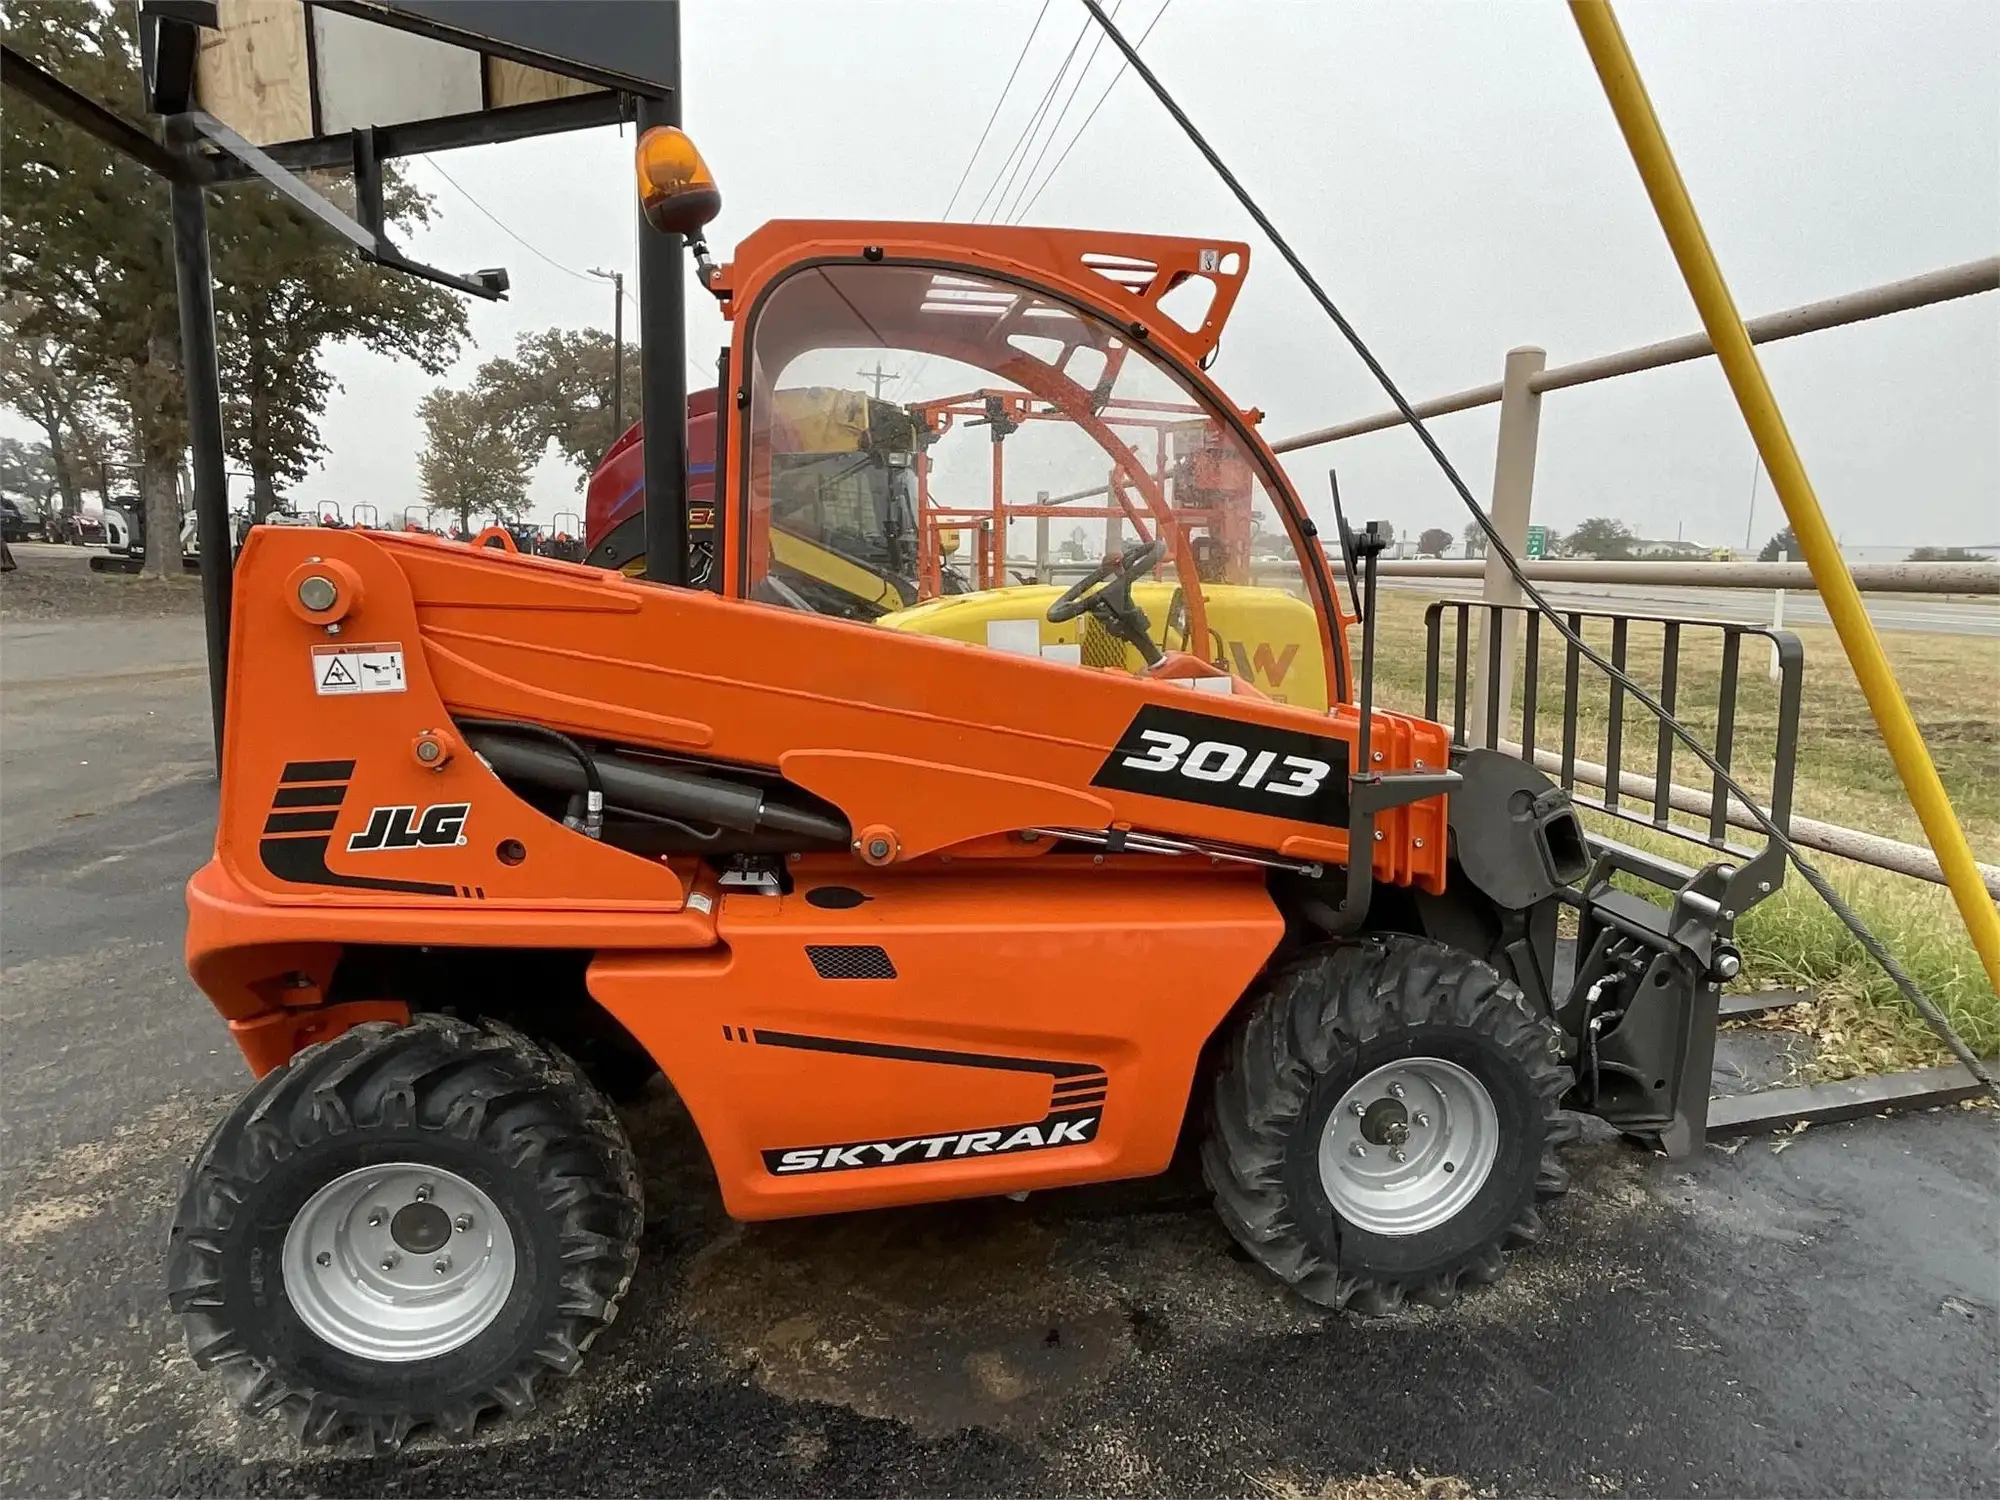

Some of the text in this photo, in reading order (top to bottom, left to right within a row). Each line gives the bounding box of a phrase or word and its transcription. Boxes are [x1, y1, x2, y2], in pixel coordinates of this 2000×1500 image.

[1121, 729, 1331, 797] 3013
[346, 803, 471, 851] JLG
[776, 1116, 1096, 1172] SKYTRAK
